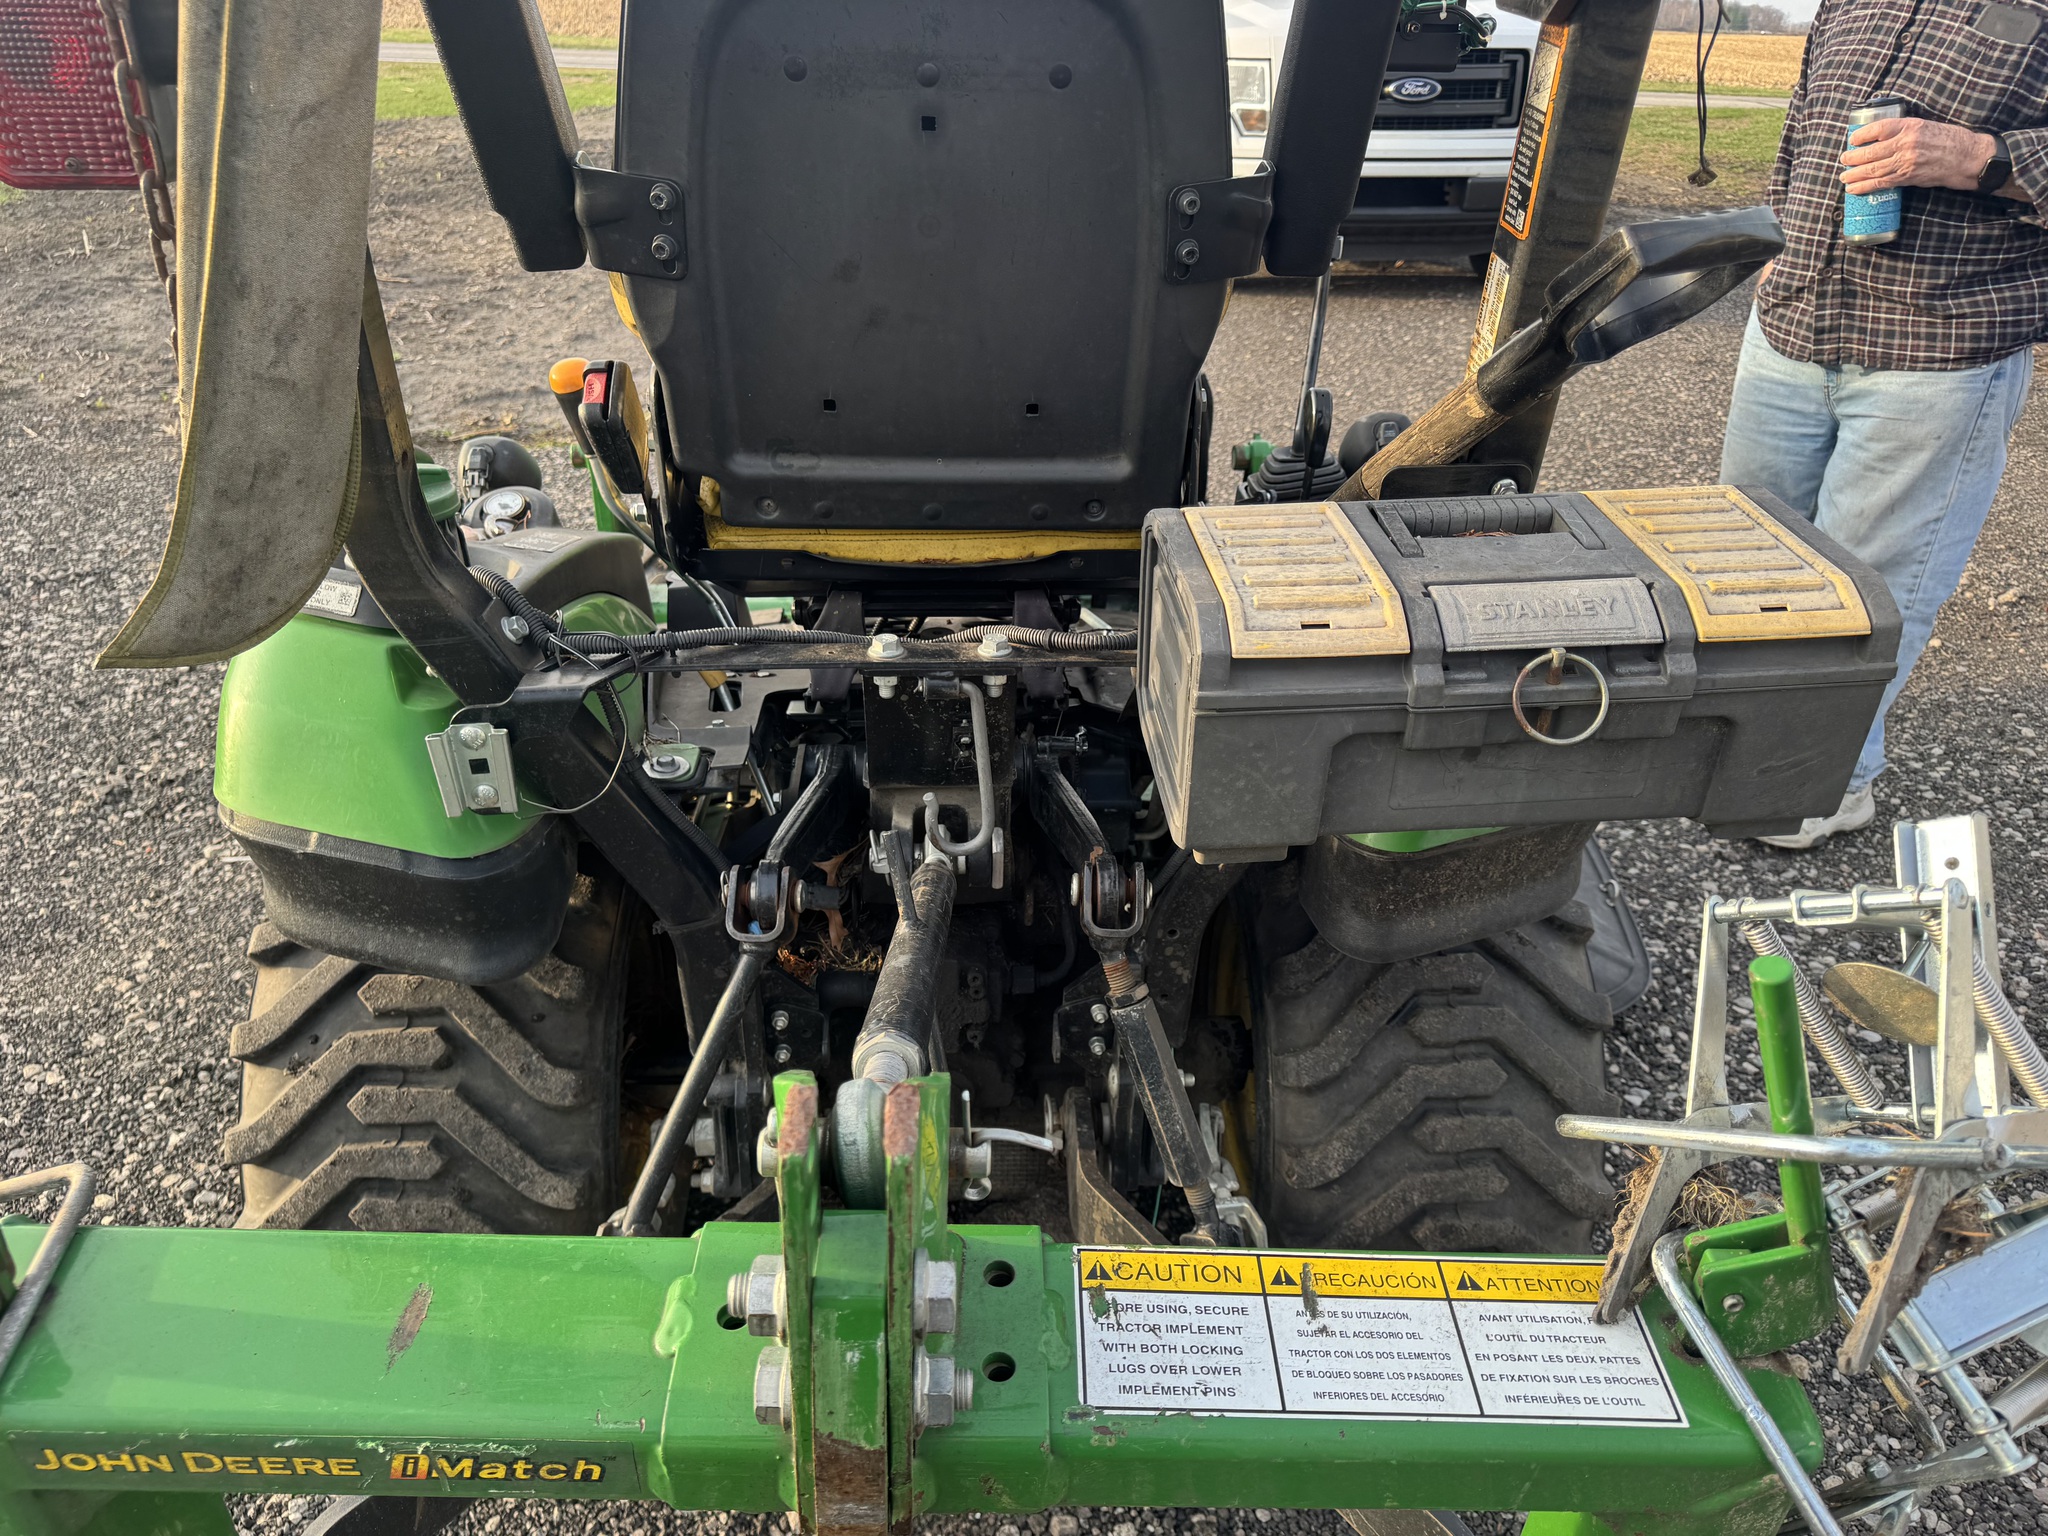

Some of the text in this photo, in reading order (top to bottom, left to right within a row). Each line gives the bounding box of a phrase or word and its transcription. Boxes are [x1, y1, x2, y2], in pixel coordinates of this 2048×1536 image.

[1401, 81, 1431, 95] Ford
[1477, 597, 1615, 620] STANLEY
[1114, 1261, 1243, 1284] CAUTION
[1299, 1272, 1437, 1289] RECAUCIÓN
[1486, 1277, 1600, 1293] ATTENTION
[1146, 1303, 1192, 1316] USING,
[1195, 1305, 1250, 1316] SECURE
[1296, 1309, 1412, 1321] ANES DE SU UTILIZACIÓN,
[1479, 1314, 1513, 1323] AVANT
[1515, 1315, 1586, 1326] UTILISATION,
[1098, 1322, 1243, 1335] TRACTOR IMPLEMENT
[1296, 1329, 1424, 1340] SUJETAR EL ACCESORIO DEL
[1529, 1334, 1545, 1343] DU
[1545, 1335, 1607, 1344] TRACTEUR
[1102, 1342, 1244, 1356] WITH BOTH LOCKING
[1289, 1349, 1451, 1361] TRACTOR CON LOS DOS ELEMENTOS
[1475, 1353, 1641, 1365] EN POSANT LES DEUX PATTES
[1108, 1363, 1242, 1376] LUGS OVER LOWER
[1292, 1370, 1464, 1382] DE BLOQUEO SOBRE LOS PASADORES
[1481, 1373, 1660, 1386] DE FIXATION SUR LES BROCHES
[1118, 1384, 1237, 1397] IMPLEMENT PINS
[1313, 1391, 1445, 1402] INFERIORES DEL ACCESORIO
[1505, 1394, 1582, 1405] INFÉRIEURES
[1584, 1396, 1600, 1405] DE
[35, 1448, 362, 1476] JOHN DEERE
